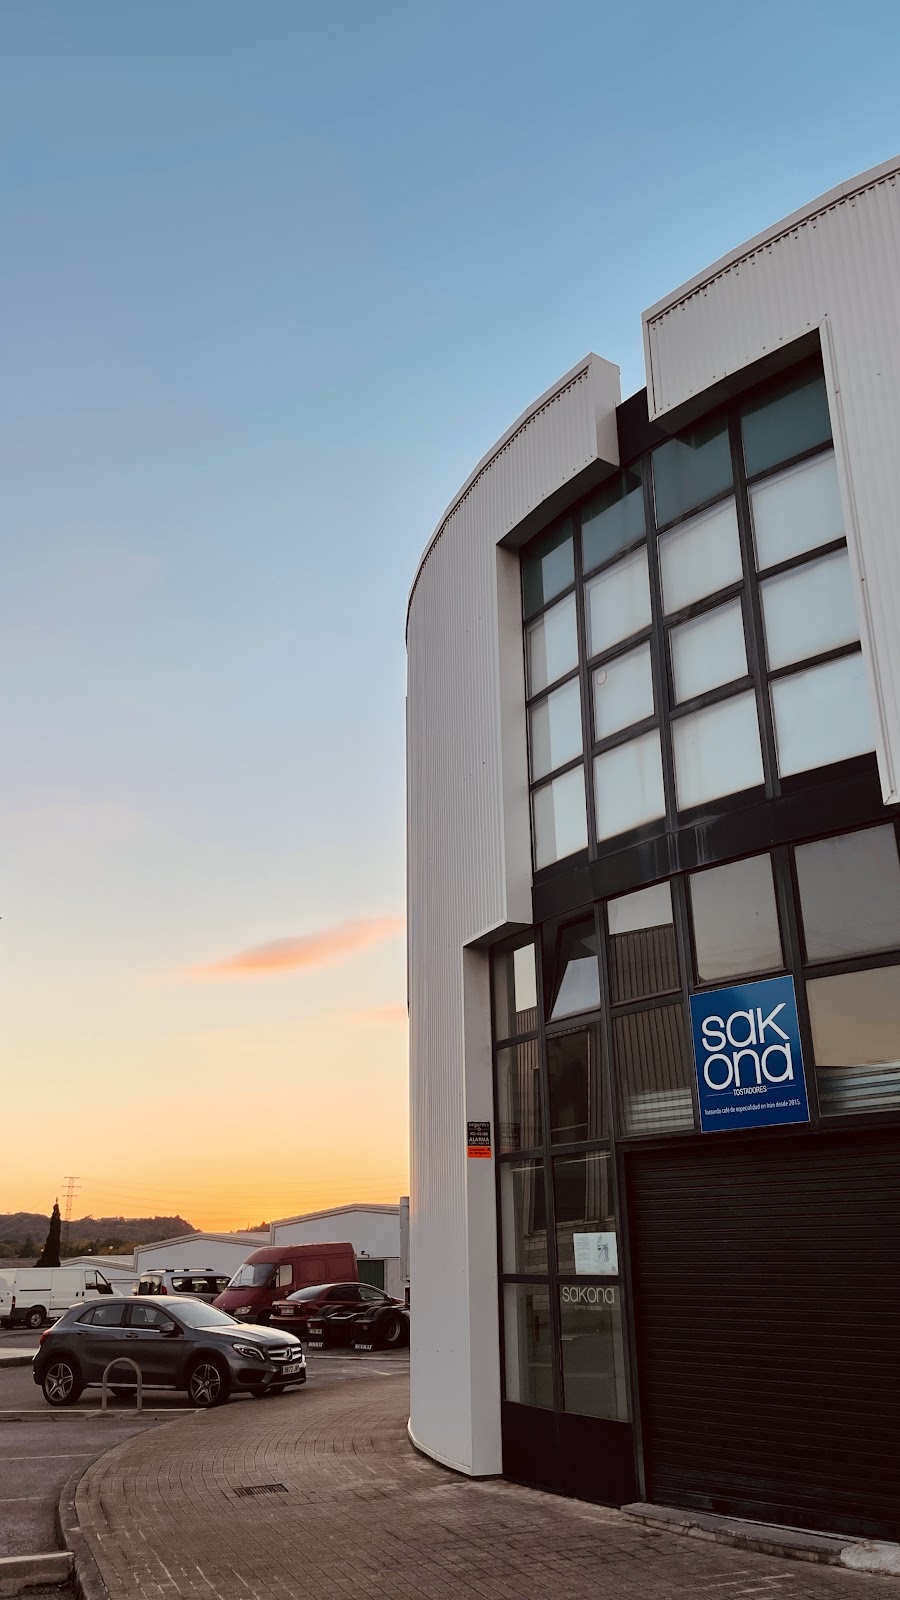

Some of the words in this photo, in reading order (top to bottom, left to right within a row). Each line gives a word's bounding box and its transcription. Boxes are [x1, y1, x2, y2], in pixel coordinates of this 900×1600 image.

[701, 1002, 790, 1052] sak
[703, 1042, 794, 1090] ona
[733, 1085, 767, 1096] TOSTADORES
[730, 1105, 736, 1113] de
[736, 1102, 760, 1113] especialidad
[775, 1100, 788, 1108] desde
[562, 1286, 615, 1304] sakona
